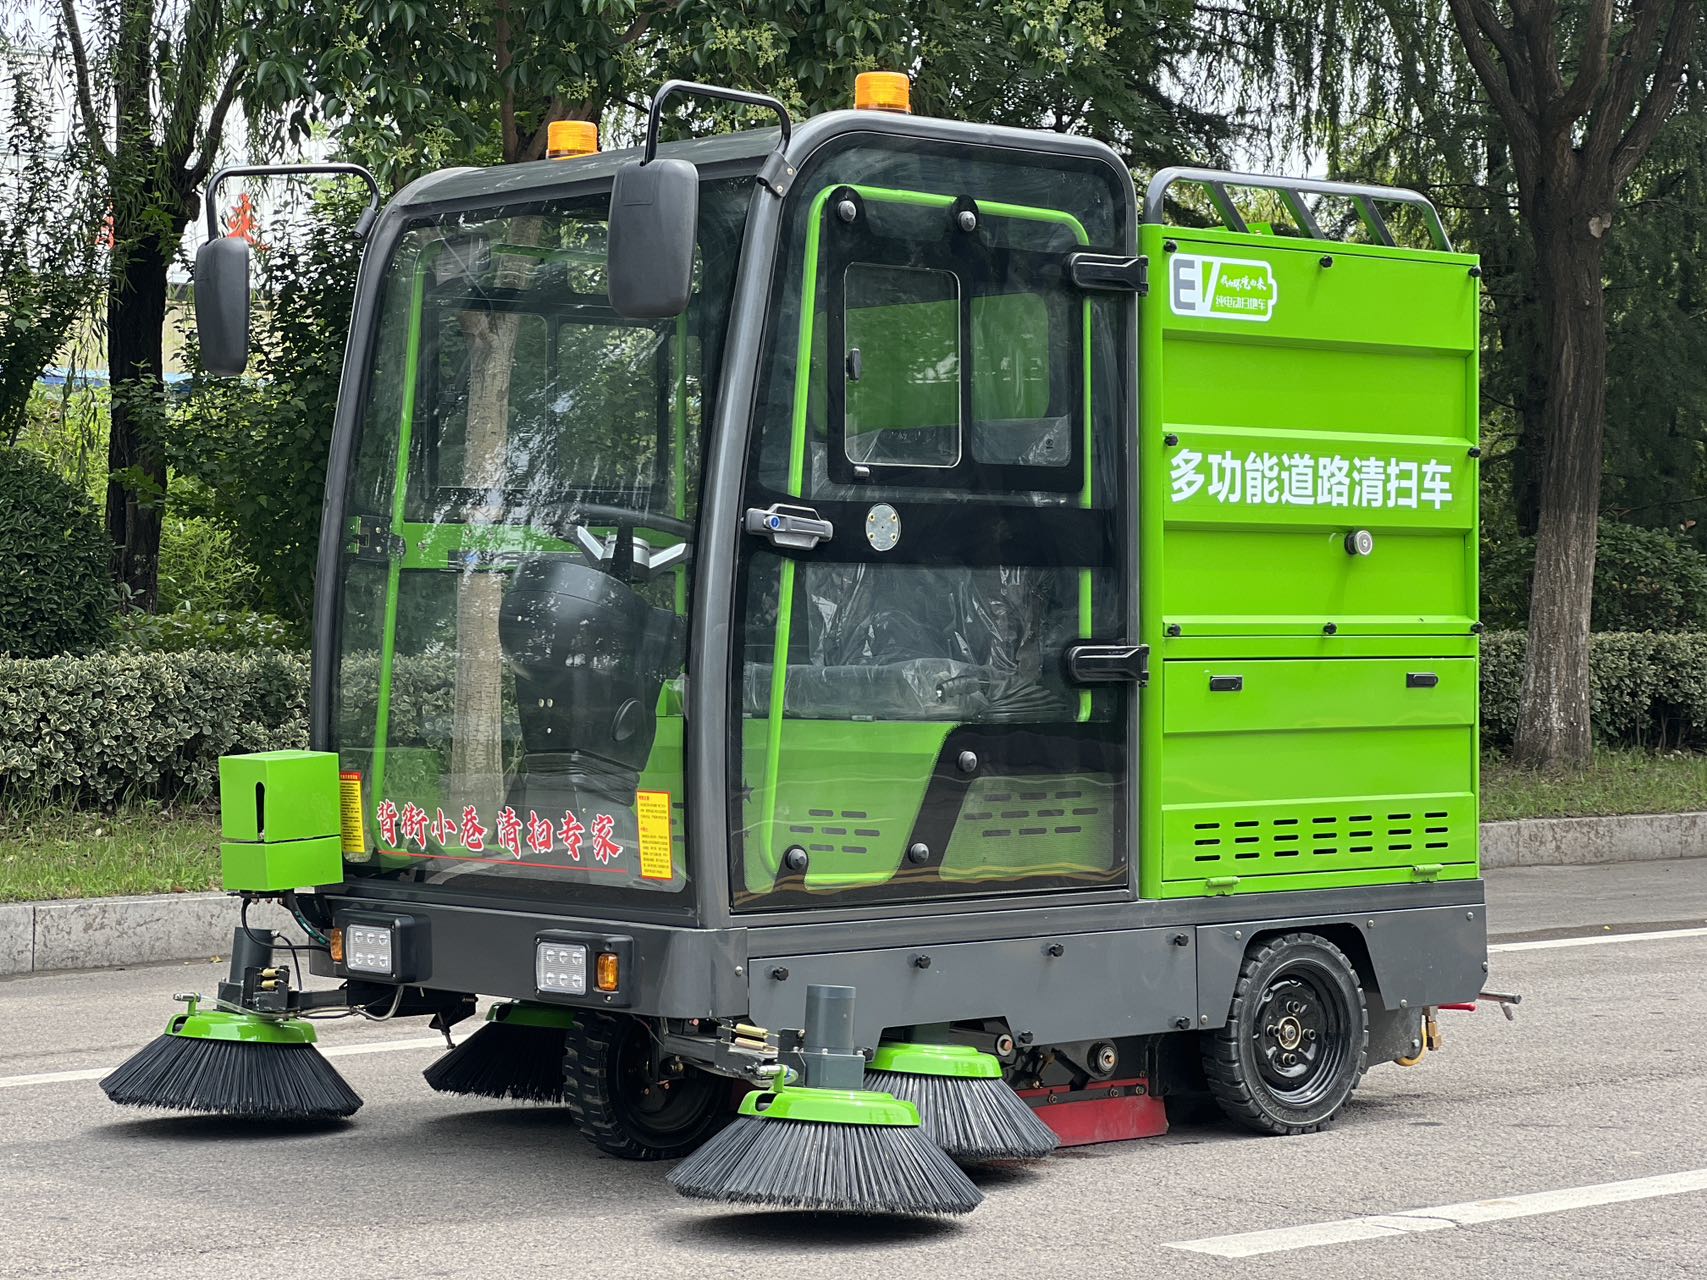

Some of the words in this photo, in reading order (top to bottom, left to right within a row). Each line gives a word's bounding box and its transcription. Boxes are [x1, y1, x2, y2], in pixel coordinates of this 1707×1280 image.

[1173, 257, 1221, 316] EV
[1169, 448, 1453, 510] 多功能道路清扫车
[376, 799, 488, 851] 背街小巷
[496, 804, 624, 865] 清扫专家
